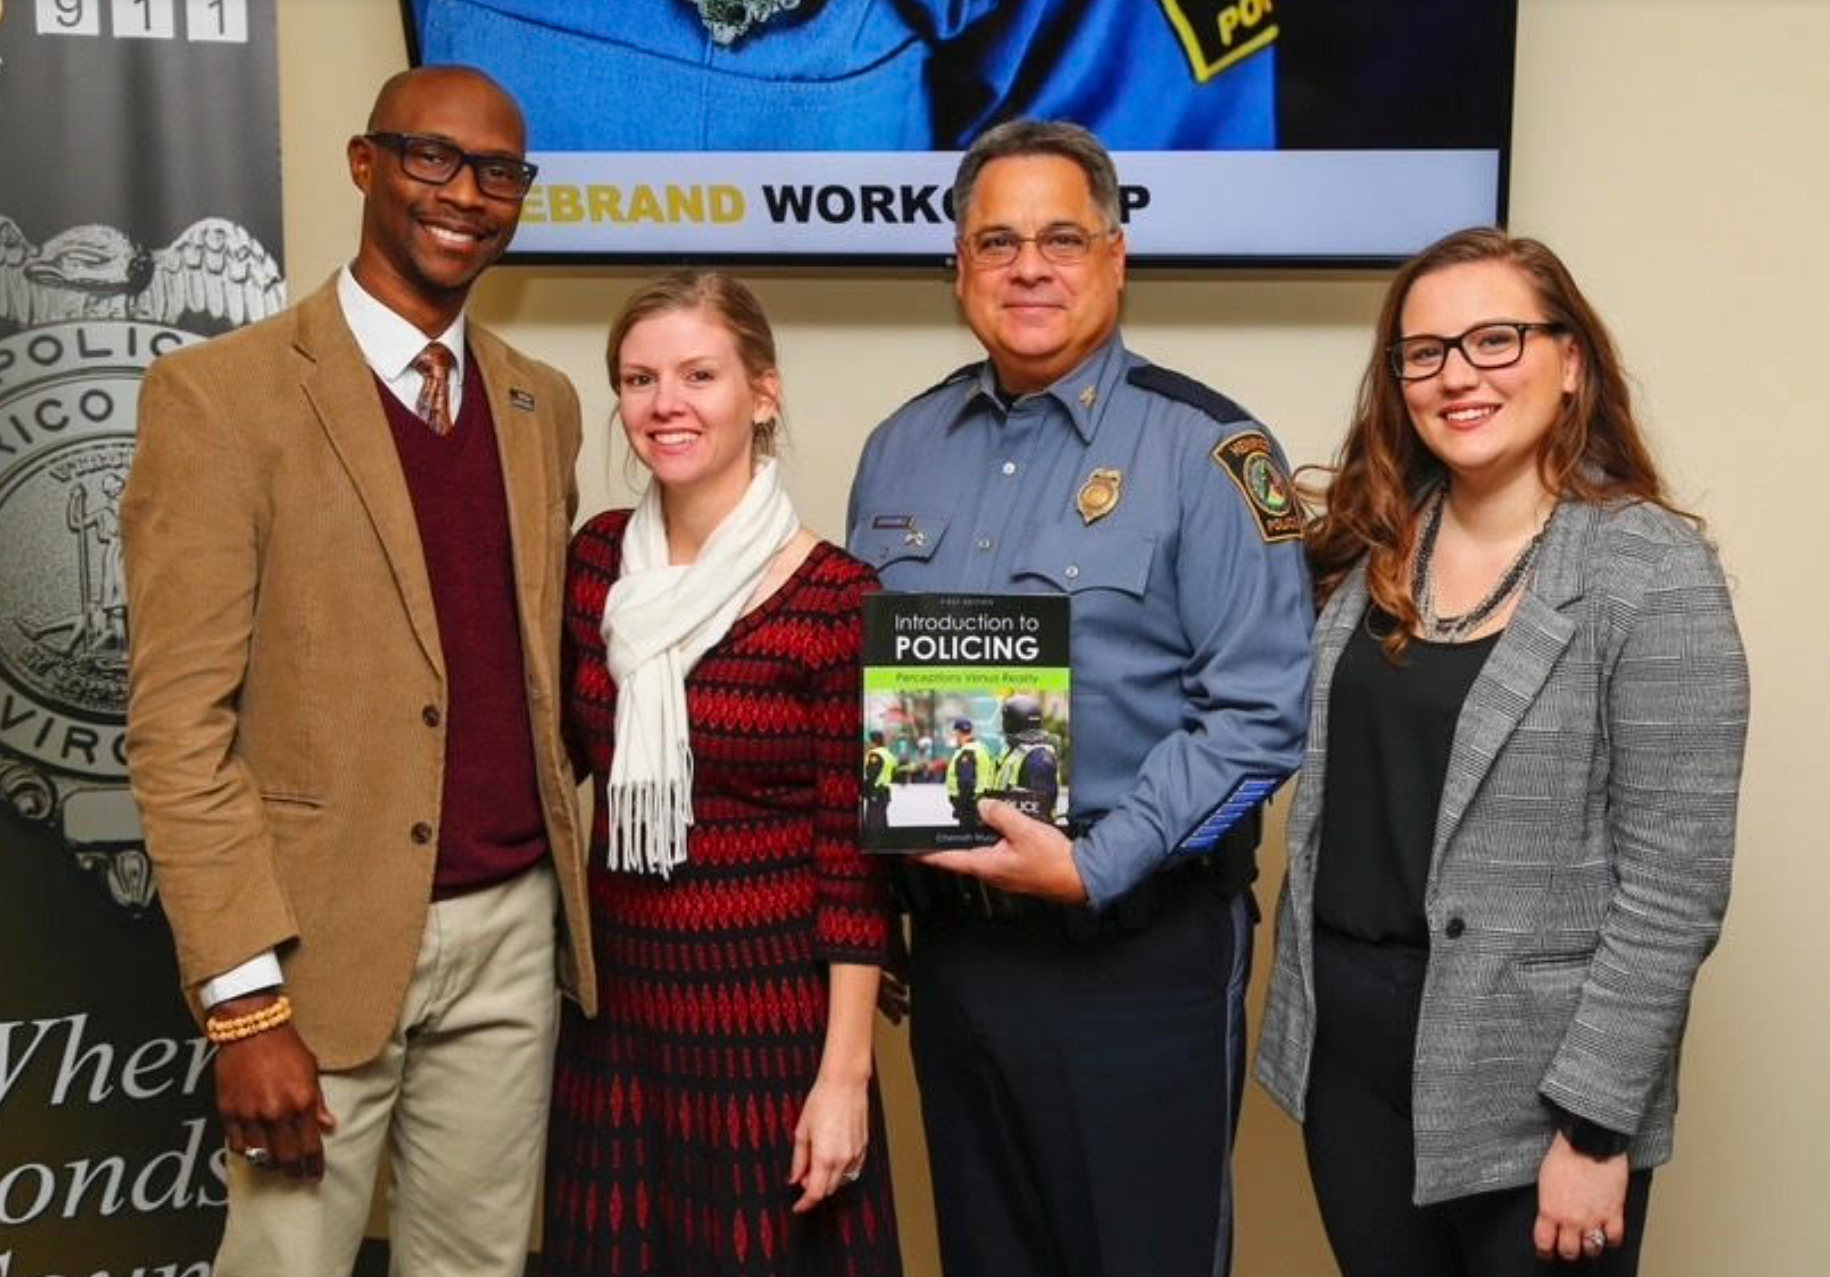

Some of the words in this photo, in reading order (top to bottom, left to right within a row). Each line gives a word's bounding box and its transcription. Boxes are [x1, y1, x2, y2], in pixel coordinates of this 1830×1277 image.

[56, 0, 83, 27] 9
[133, 0, 151, 31] 1
[207, 0, 226, 35] 1
[520, 184, 746, 223] EBRAND
[762, 184, 1151, 224] WORKP
[895, 613, 1014, 632] Introduction
[1019, 614, 1040, 632] to
[896, 635, 1040, 661] POLICING
[896, 672, 962, 687] Perceptions
